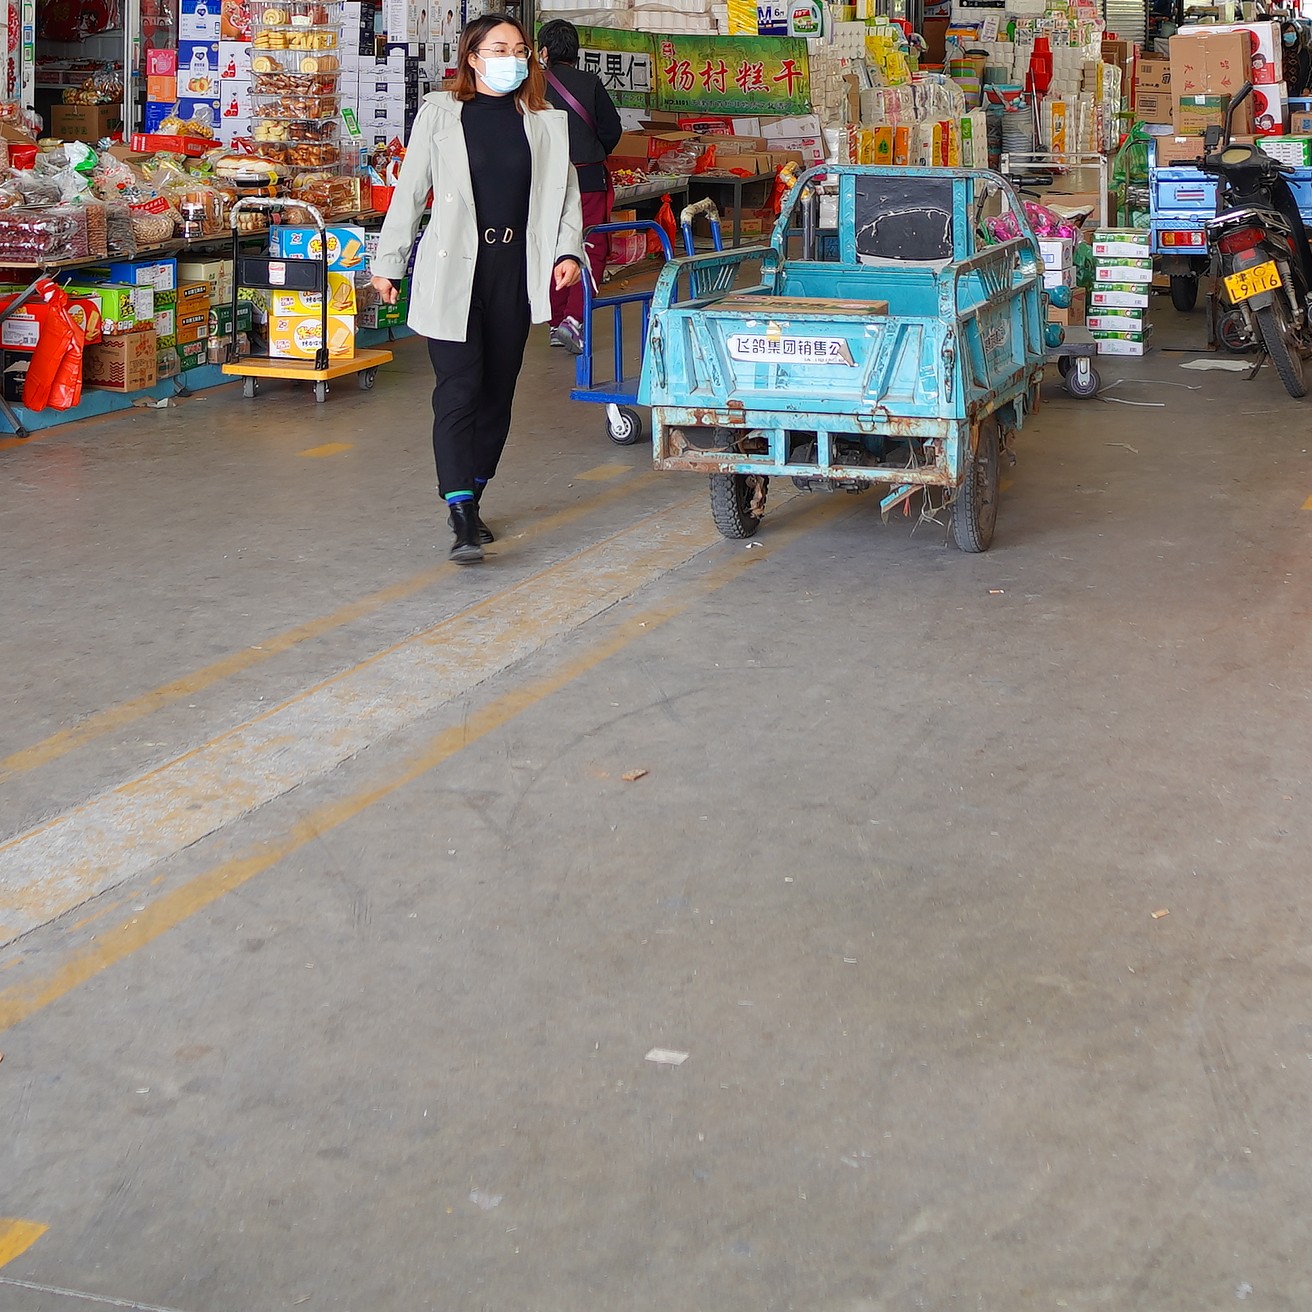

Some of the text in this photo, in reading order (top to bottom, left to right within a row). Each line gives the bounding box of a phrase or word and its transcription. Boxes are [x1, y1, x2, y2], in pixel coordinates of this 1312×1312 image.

[663, 59, 804, 99] 杨村糕干
[1231, 274, 1278, 301] L9116
